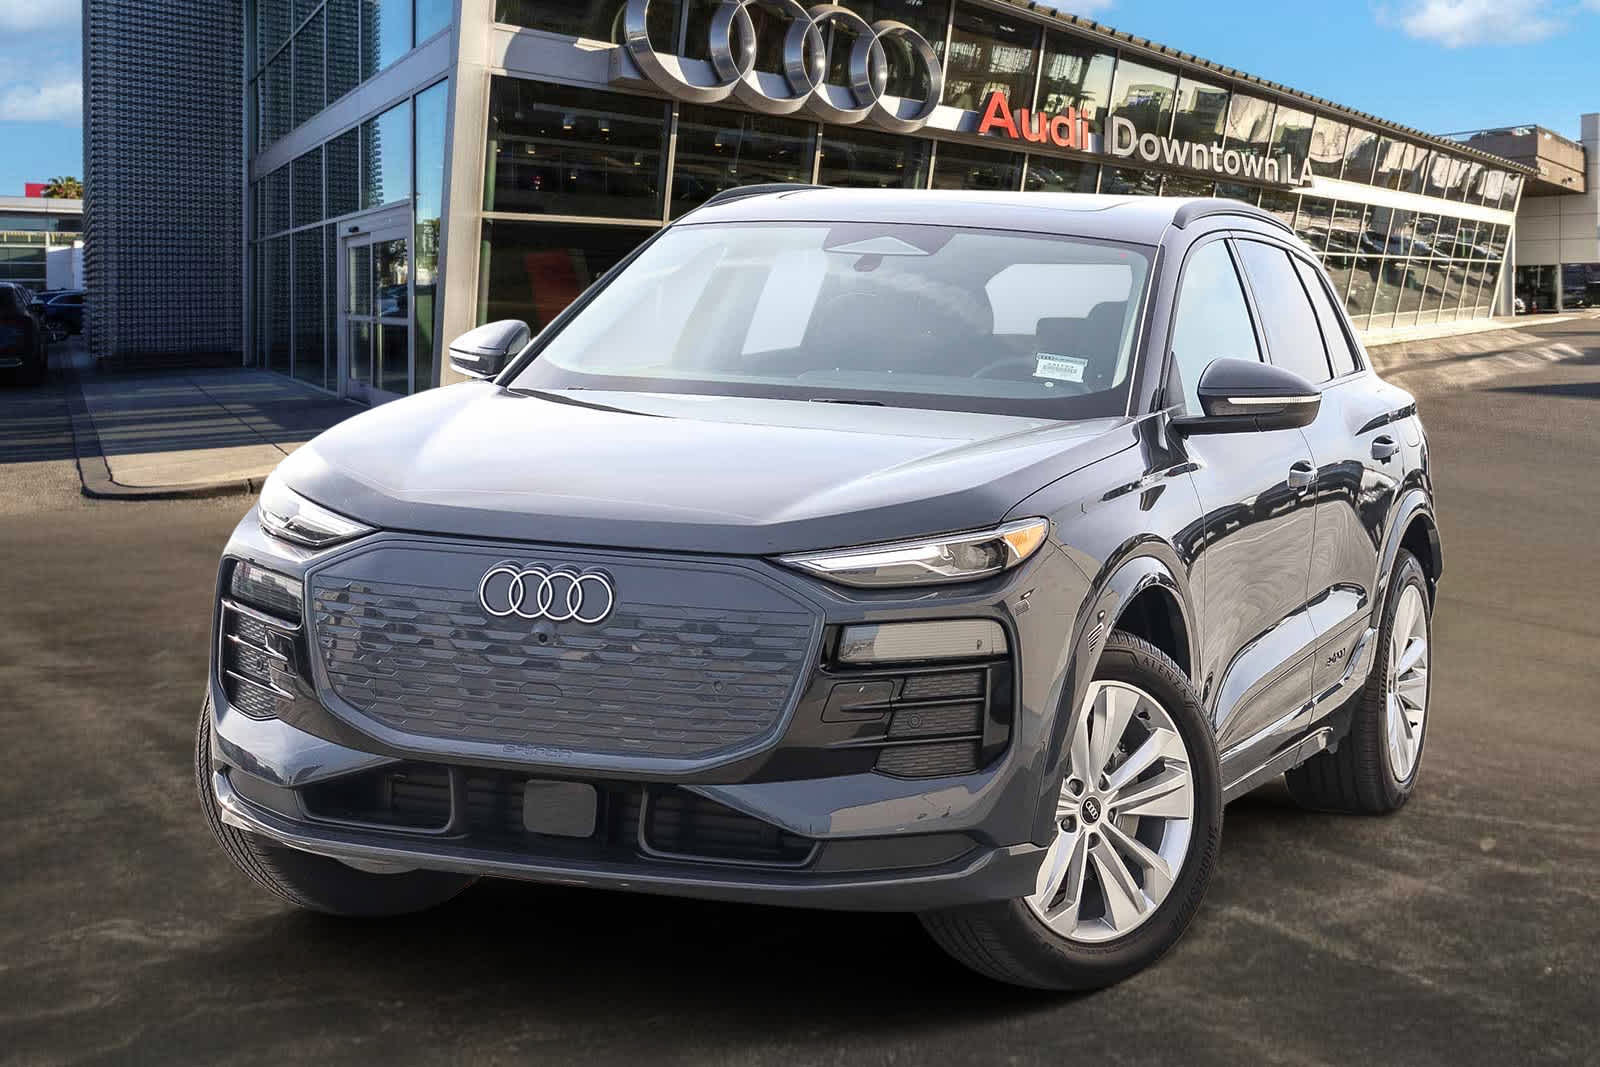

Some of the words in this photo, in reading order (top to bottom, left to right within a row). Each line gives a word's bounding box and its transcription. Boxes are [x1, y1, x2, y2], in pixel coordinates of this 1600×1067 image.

[978, 90, 1089, 150] Audi
[1109, 115, 1279, 183] Downtown
[1286, 153, 1314, 187] LA
